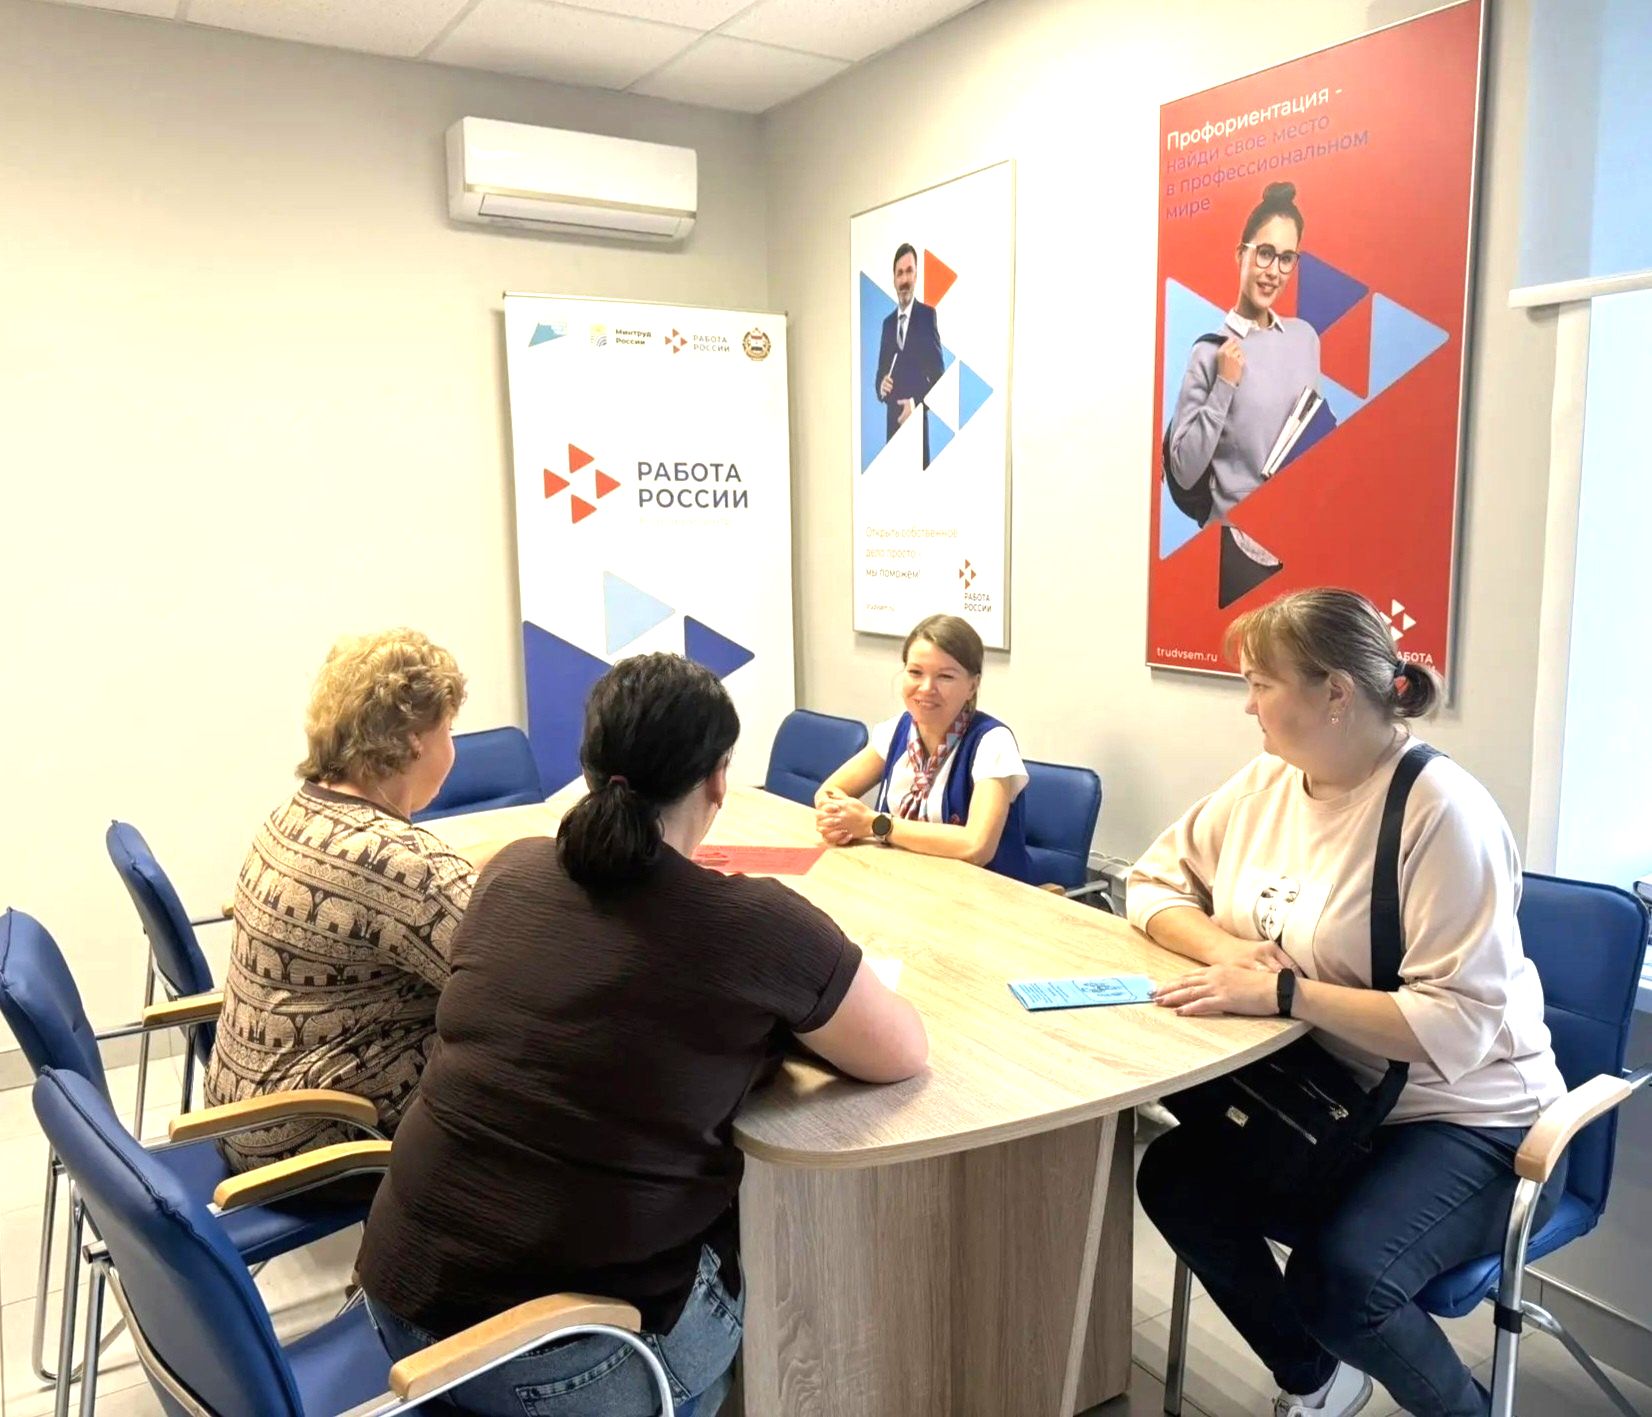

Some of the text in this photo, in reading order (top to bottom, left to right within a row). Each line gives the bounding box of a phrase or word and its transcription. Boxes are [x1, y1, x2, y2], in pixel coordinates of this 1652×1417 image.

[1167, 87, 1329, 151] Профориентация
[1167, 115, 1330, 174] найди свое место
[1167, 130, 1369, 196] в профессиональном
[1166, 197, 1210, 219] мире
[615, 337, 646, 346] России
[693, 334, 728, 344] РАБОТА
[693, 343, 731, 353] РОССИИ
[637, 461, 742, 483] РАБОТА
[638, 488, 749, 509] РОССИИ
[964, 592, 991, 603] РАБОТА
[964, 602, 992, 613] РОССИИ
[1156, 646, 1219, 663] trudvsem.ru
[1396, 651, 1434, 664] АБОТА
